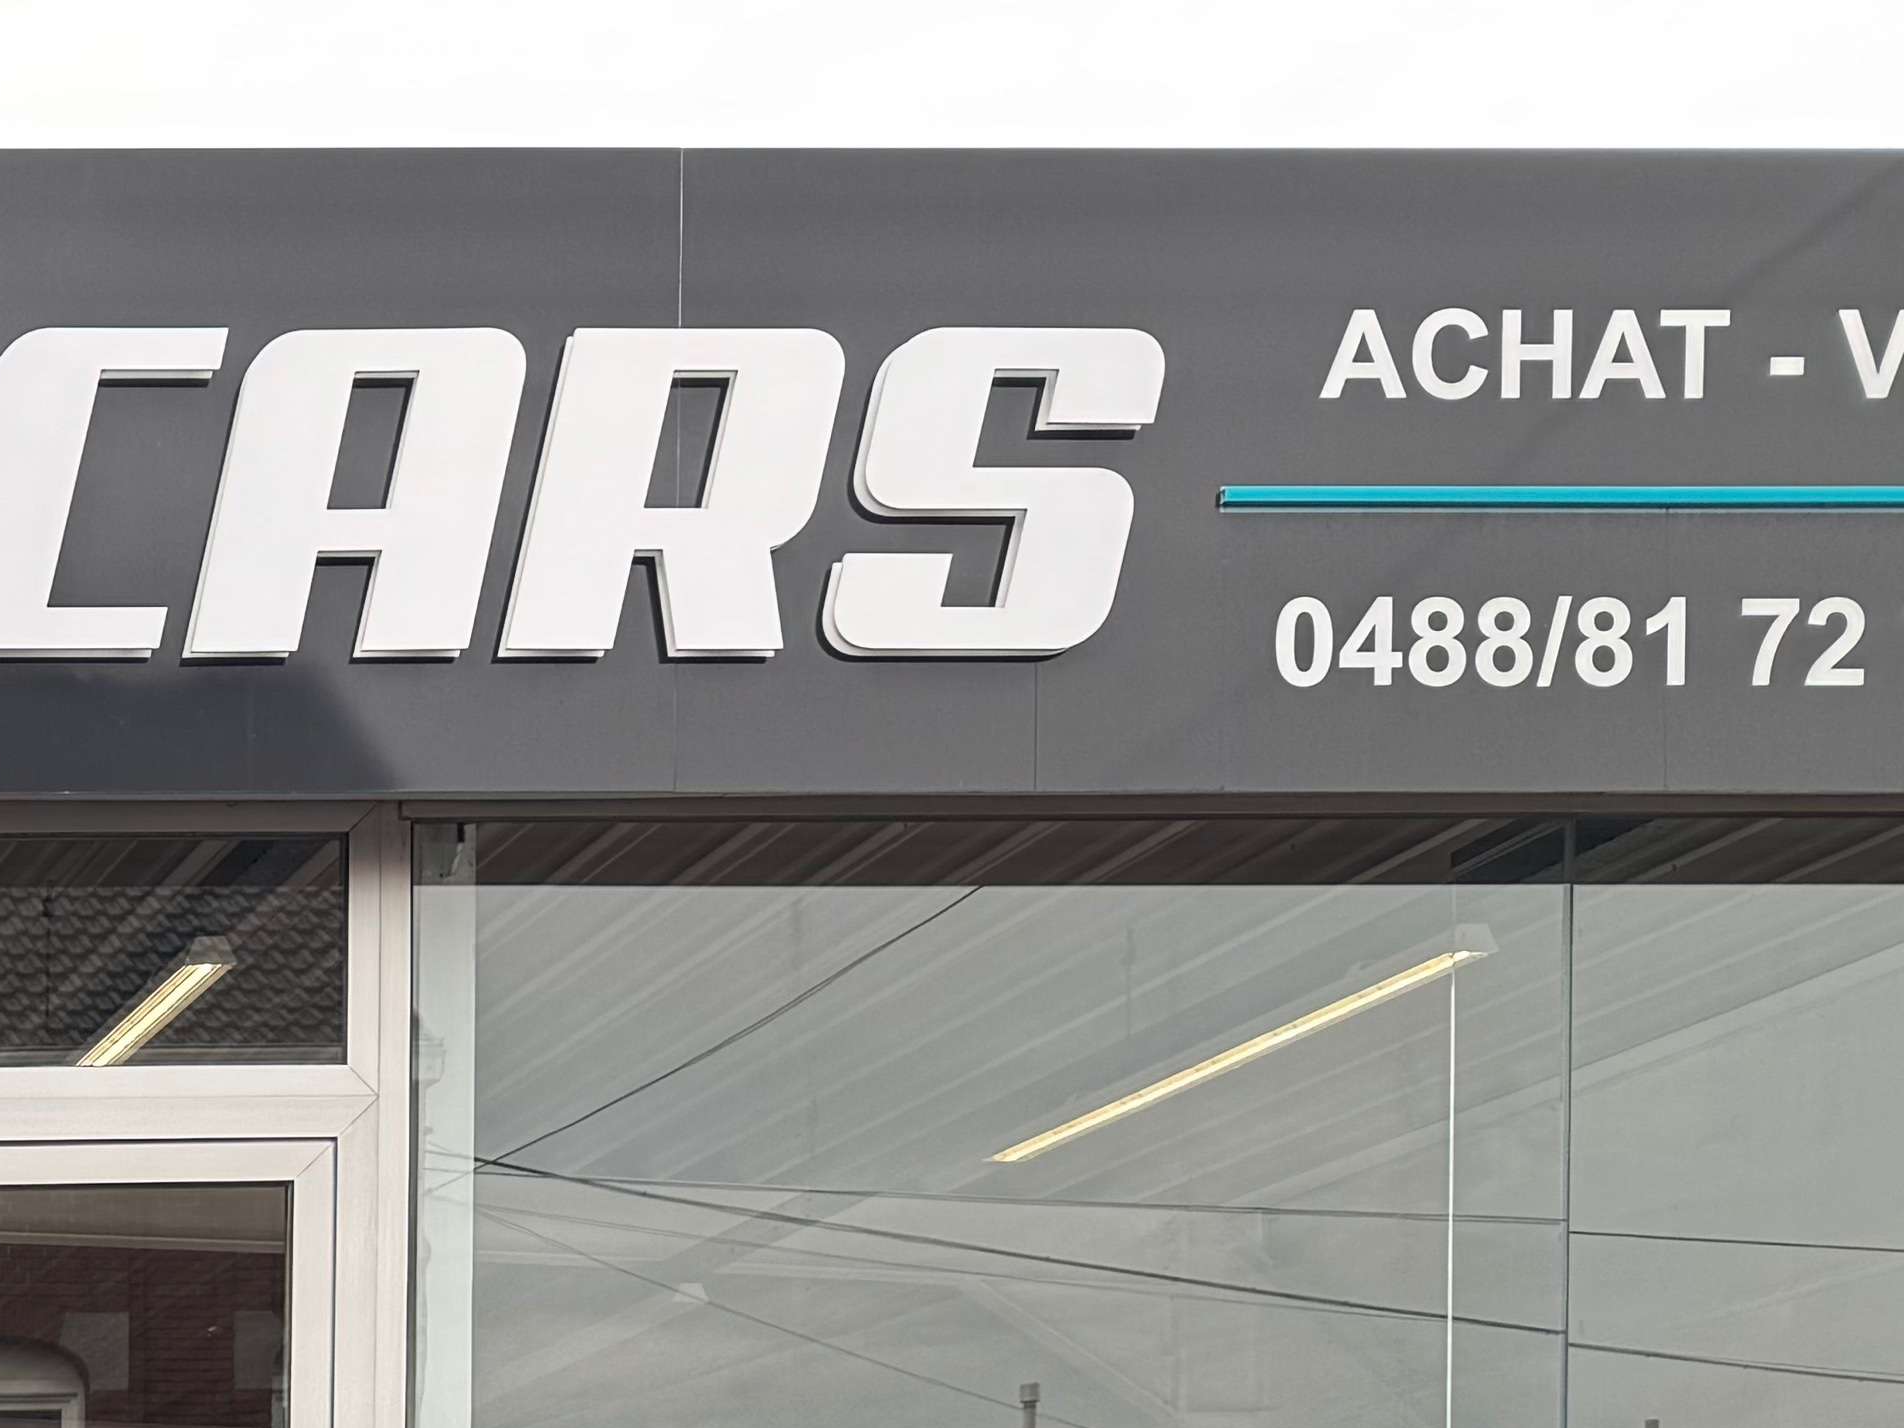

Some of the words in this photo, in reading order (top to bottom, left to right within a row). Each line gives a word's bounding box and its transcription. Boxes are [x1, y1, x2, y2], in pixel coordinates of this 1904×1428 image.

[1319, 308, 1731, 401] ACHAT
[1275, 596, 1687, 688] 0488/81
[1740, 597, 1866, 687] 72
